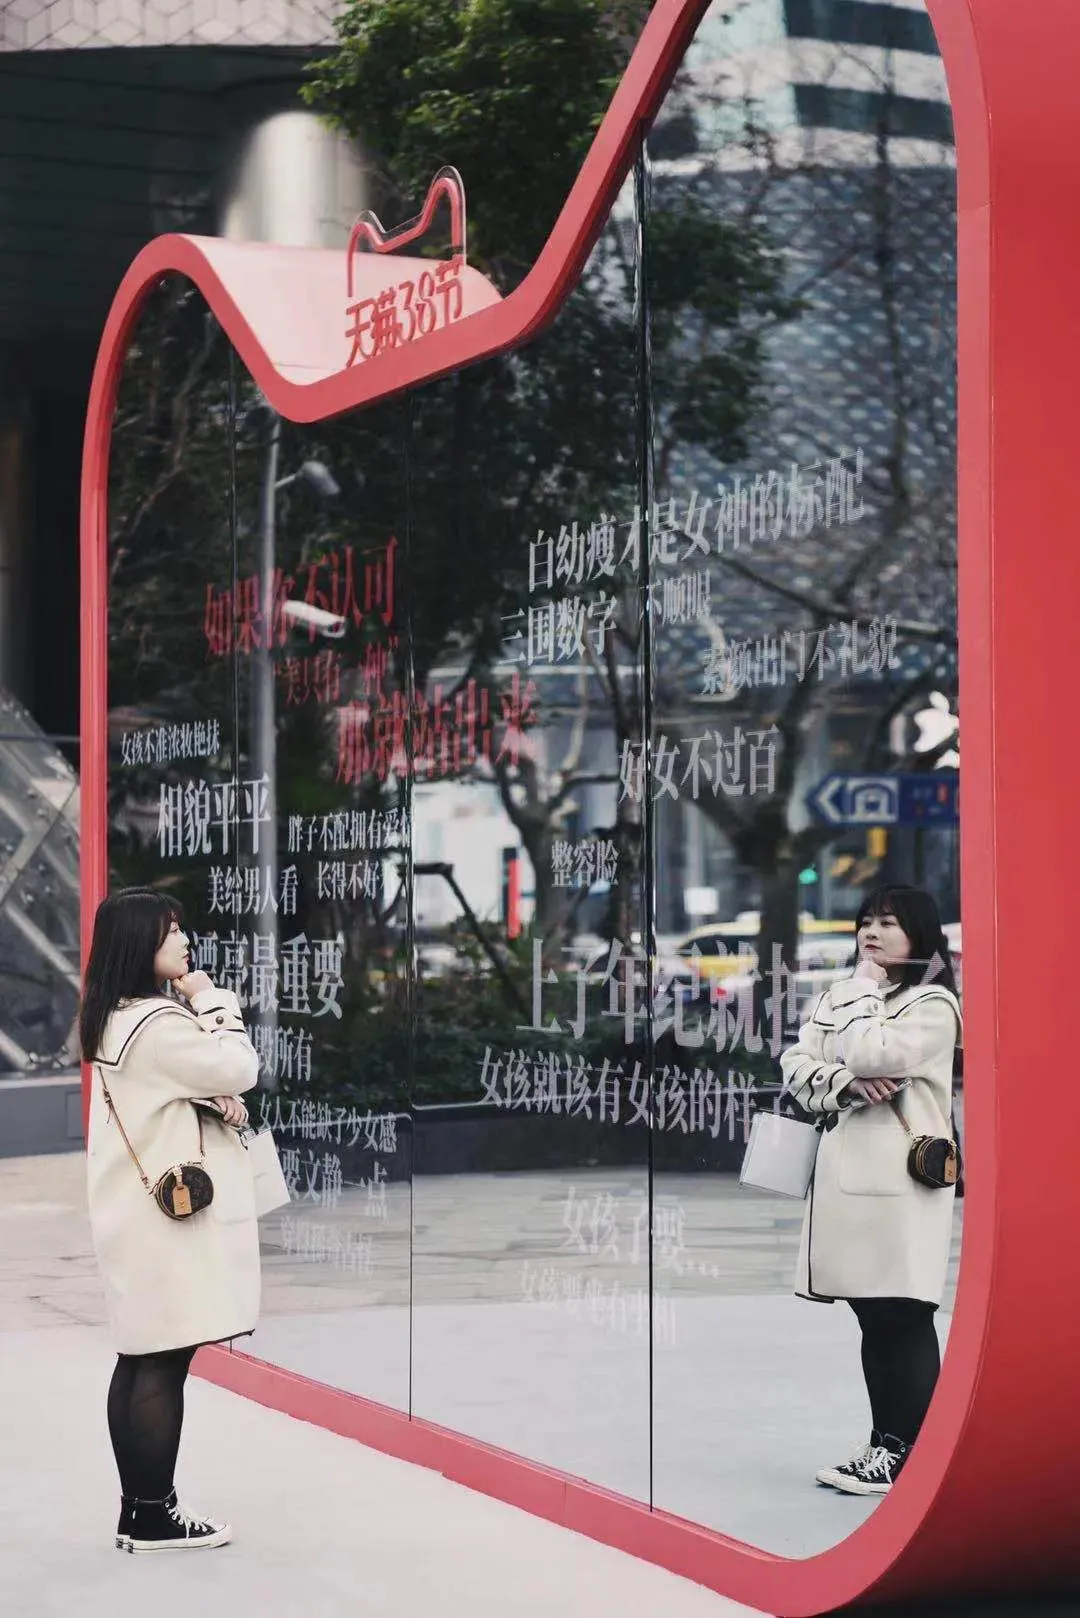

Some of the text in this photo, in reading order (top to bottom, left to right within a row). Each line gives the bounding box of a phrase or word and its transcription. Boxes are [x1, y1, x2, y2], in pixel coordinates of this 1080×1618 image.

[345, 254, 465, 368] 天猫38节
[527, 447, 865, 594] 白幼瘦才是女神的标配
[204, 534, 398, 656] 如果你不认可
[500, 592, 617, 666] 三围数字
[700, 613, 900, 697] 素颜出门不礼貌
[120, 719, 220, 767] 女孩不准浓妆艳抹
[336, 672, 539, 784] 那就站出来
[618, 723, 780, 803] 好女不过百
[157, 772, 272, 858] 相貌平平
[207, 865, 300, 916] 美给男人看
[317, 859, 397, 900] 长得不好
[550, 838, 620, 888] 整容脸
[190, 930, 345, 1021] 漂亮最重要
[248, 1023, 314, 1082] 毁所有
